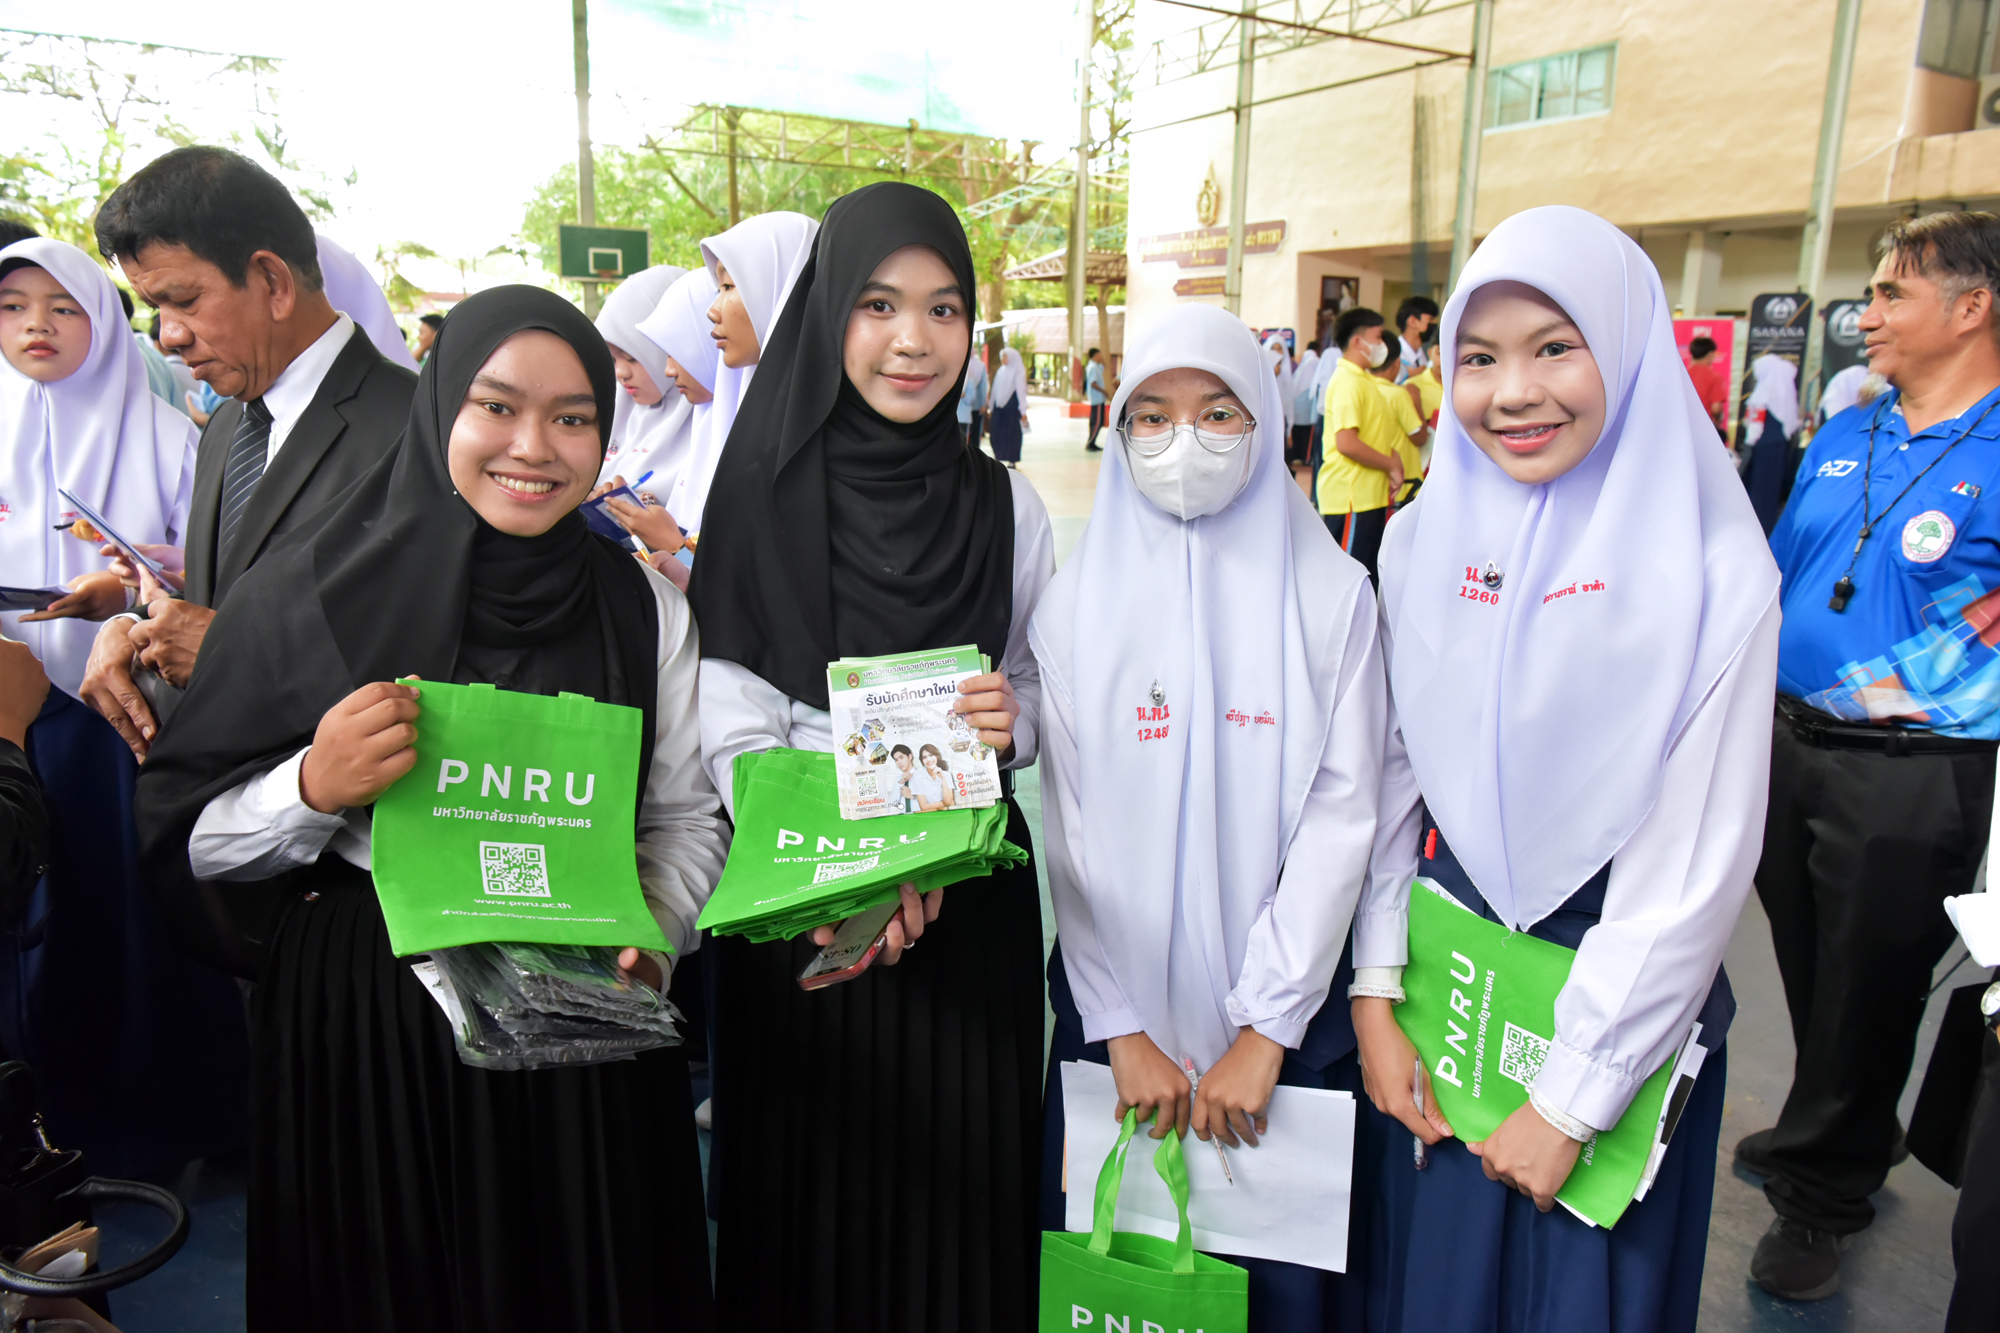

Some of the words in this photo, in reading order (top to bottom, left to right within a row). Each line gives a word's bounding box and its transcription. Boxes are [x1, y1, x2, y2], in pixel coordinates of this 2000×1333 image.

[1459, 585, 1499, 605] 1260
[866, 680, 956, 706] รับนักศึกษาใหม่
[437, 759, 595, 806] PNRU
[433, 806, 592, 828] มหาวิทยาลัยราชภัฏพระนคร
[776, 828, 927, 853] PNRU
[474, 899, 571, 909] www.pnru.ac.th
[1434, 951, 1476, 1088] PNRU
[1472, 969, 1496, 1099] มหาวิทยาลัยราชภัฏพระนคร
[1071, 1303, 1205, 1333] PNR
